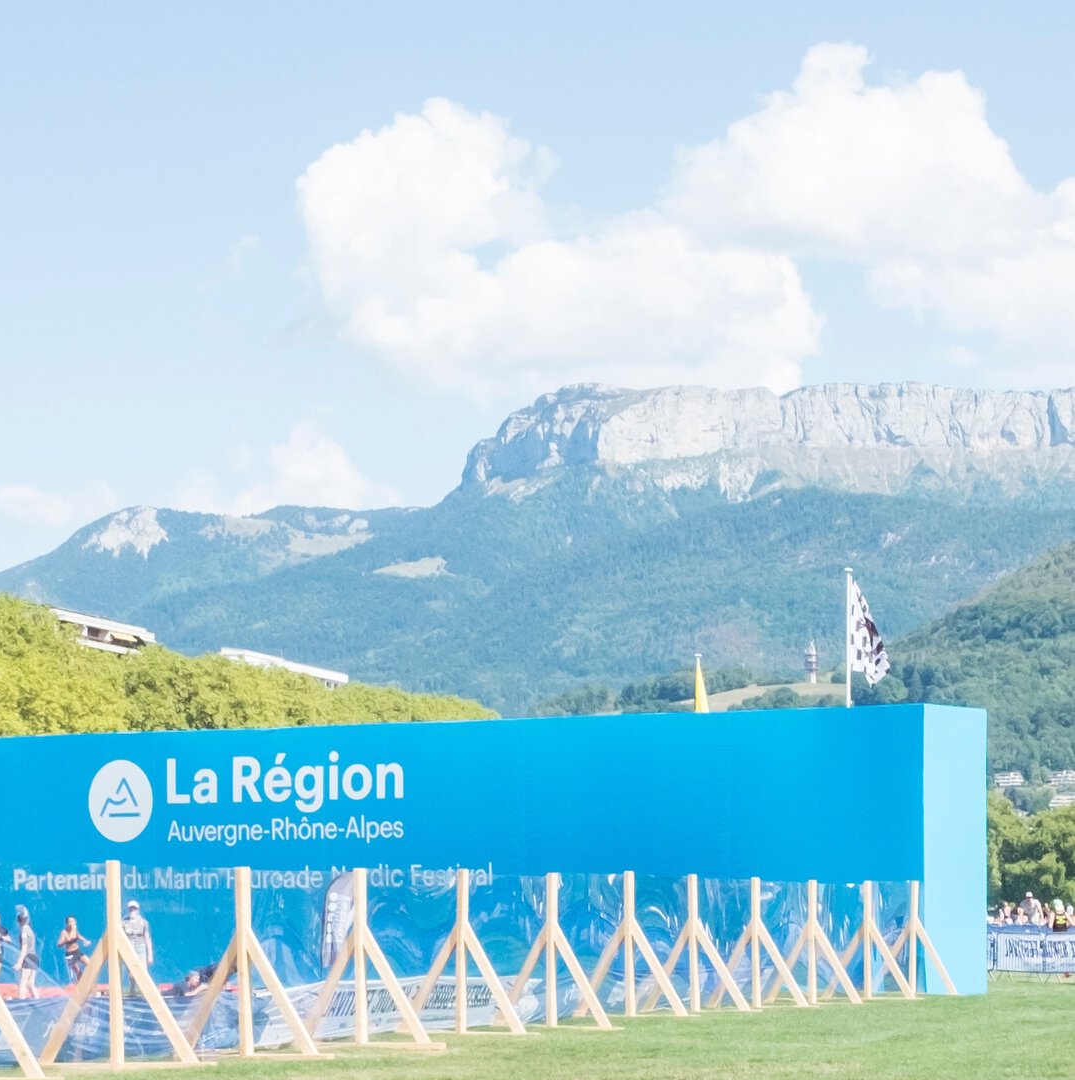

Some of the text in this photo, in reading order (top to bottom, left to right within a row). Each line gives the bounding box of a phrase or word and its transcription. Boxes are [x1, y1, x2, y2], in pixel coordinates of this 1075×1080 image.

[166, 750, 404, 813] La Région
[167, 815, 404, 847] Auvergne-Rhône-Alpes
[14, 868, 107, 890] Partenair
[125, 866, 148, 889] du
[155, 866, 219, 889] Martin
[226, 865, 323, 889] Furcade
[410, 861, 492, 887] Festval
